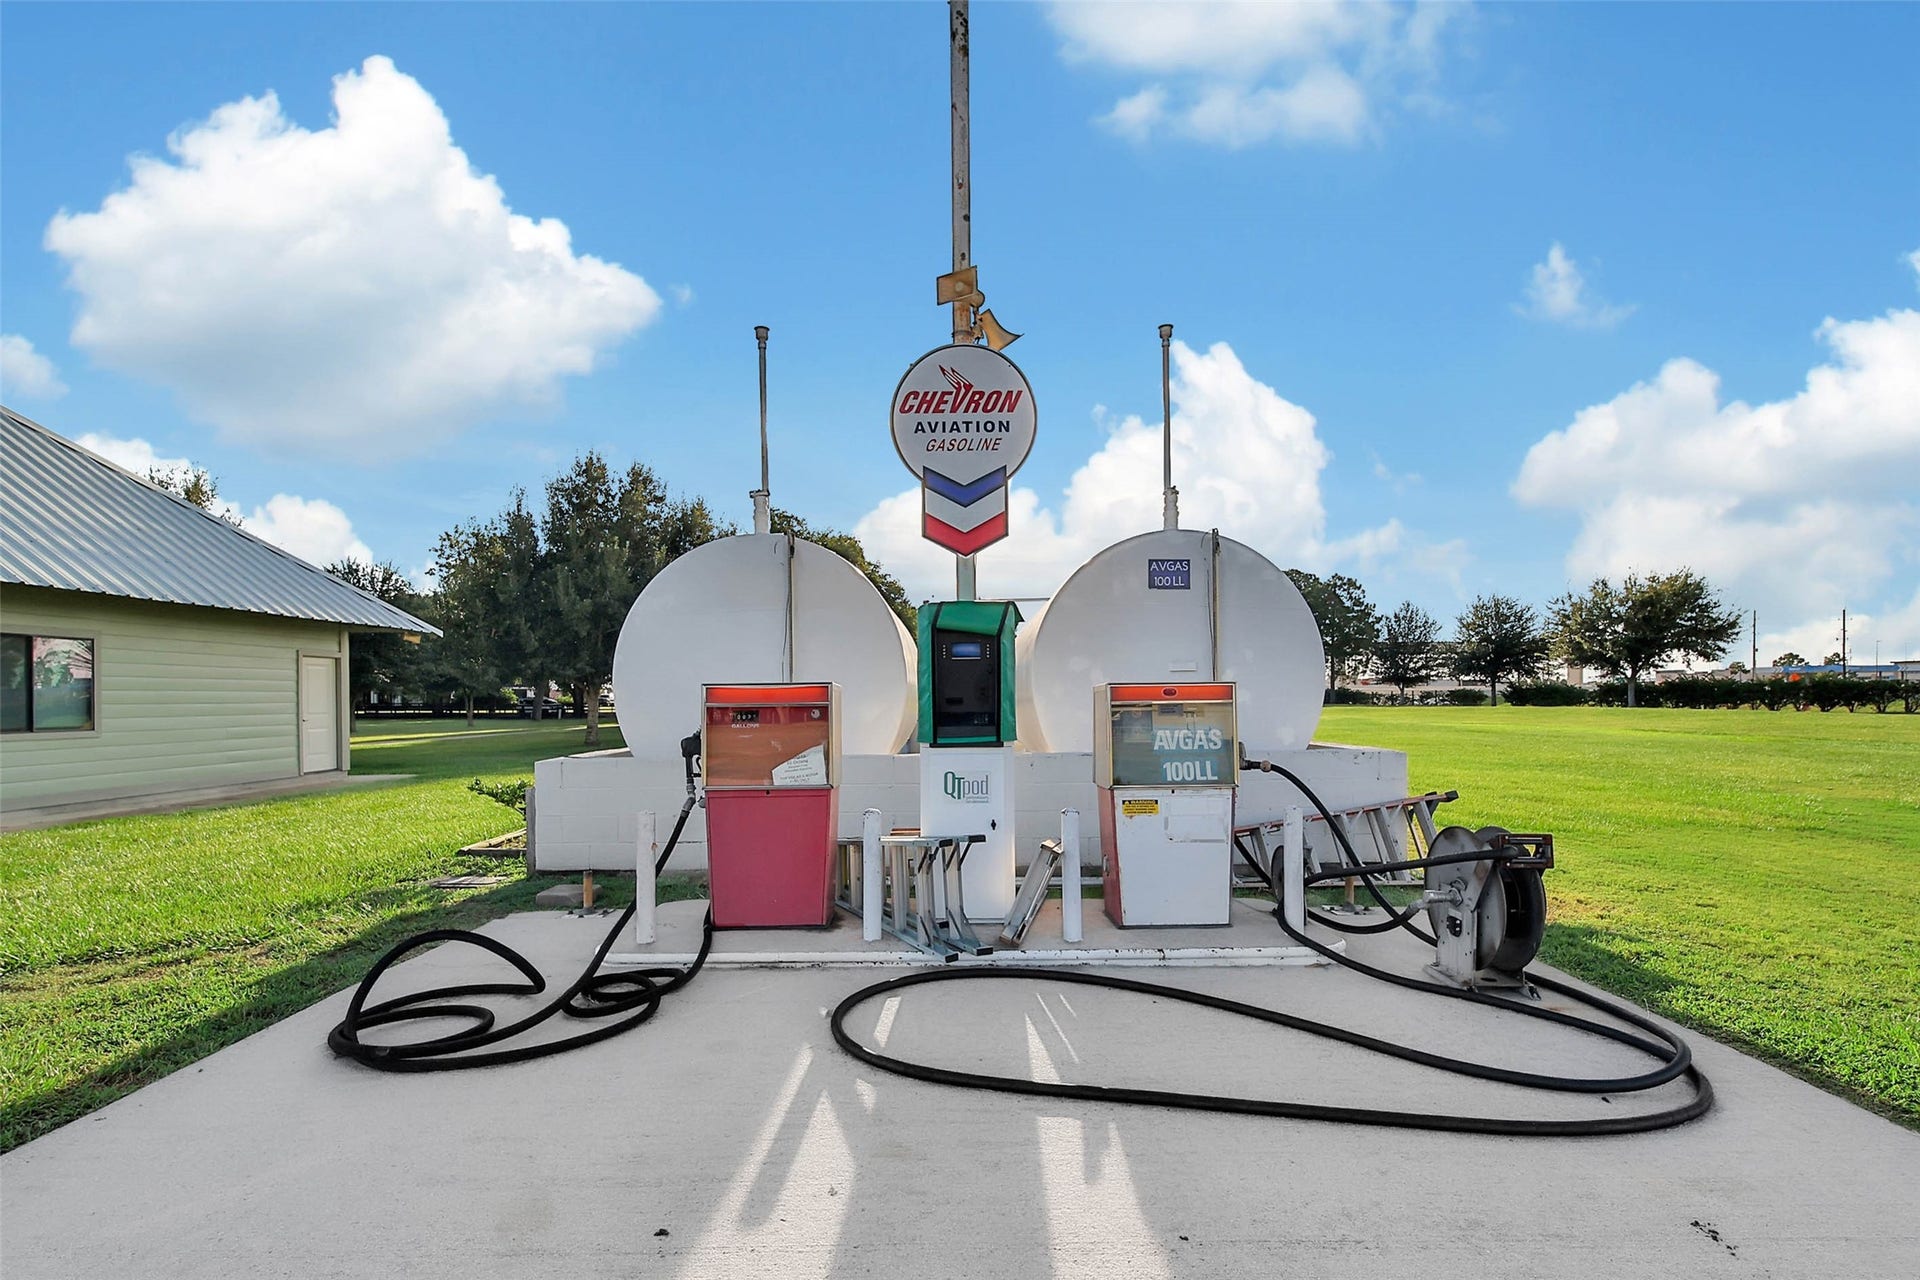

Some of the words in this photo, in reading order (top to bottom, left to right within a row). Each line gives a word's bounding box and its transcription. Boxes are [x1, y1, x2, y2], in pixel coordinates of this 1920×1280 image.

[899, 383, 1023, 414] CHEVRON
[914, 420, 1010, 434] AVIATION
[926, 438, 1002, 452] GASOLINE
[1150, 561, 1189, 571] AVGAS
[1154, 576, 1171, 586] 100
[1173, 576, 1185, 586] LL
[1153, 729, 1222, 750] AVGAS
[1162, 760, 1218, 781] 100LL
[944, 771, 989, 800] QTpod
